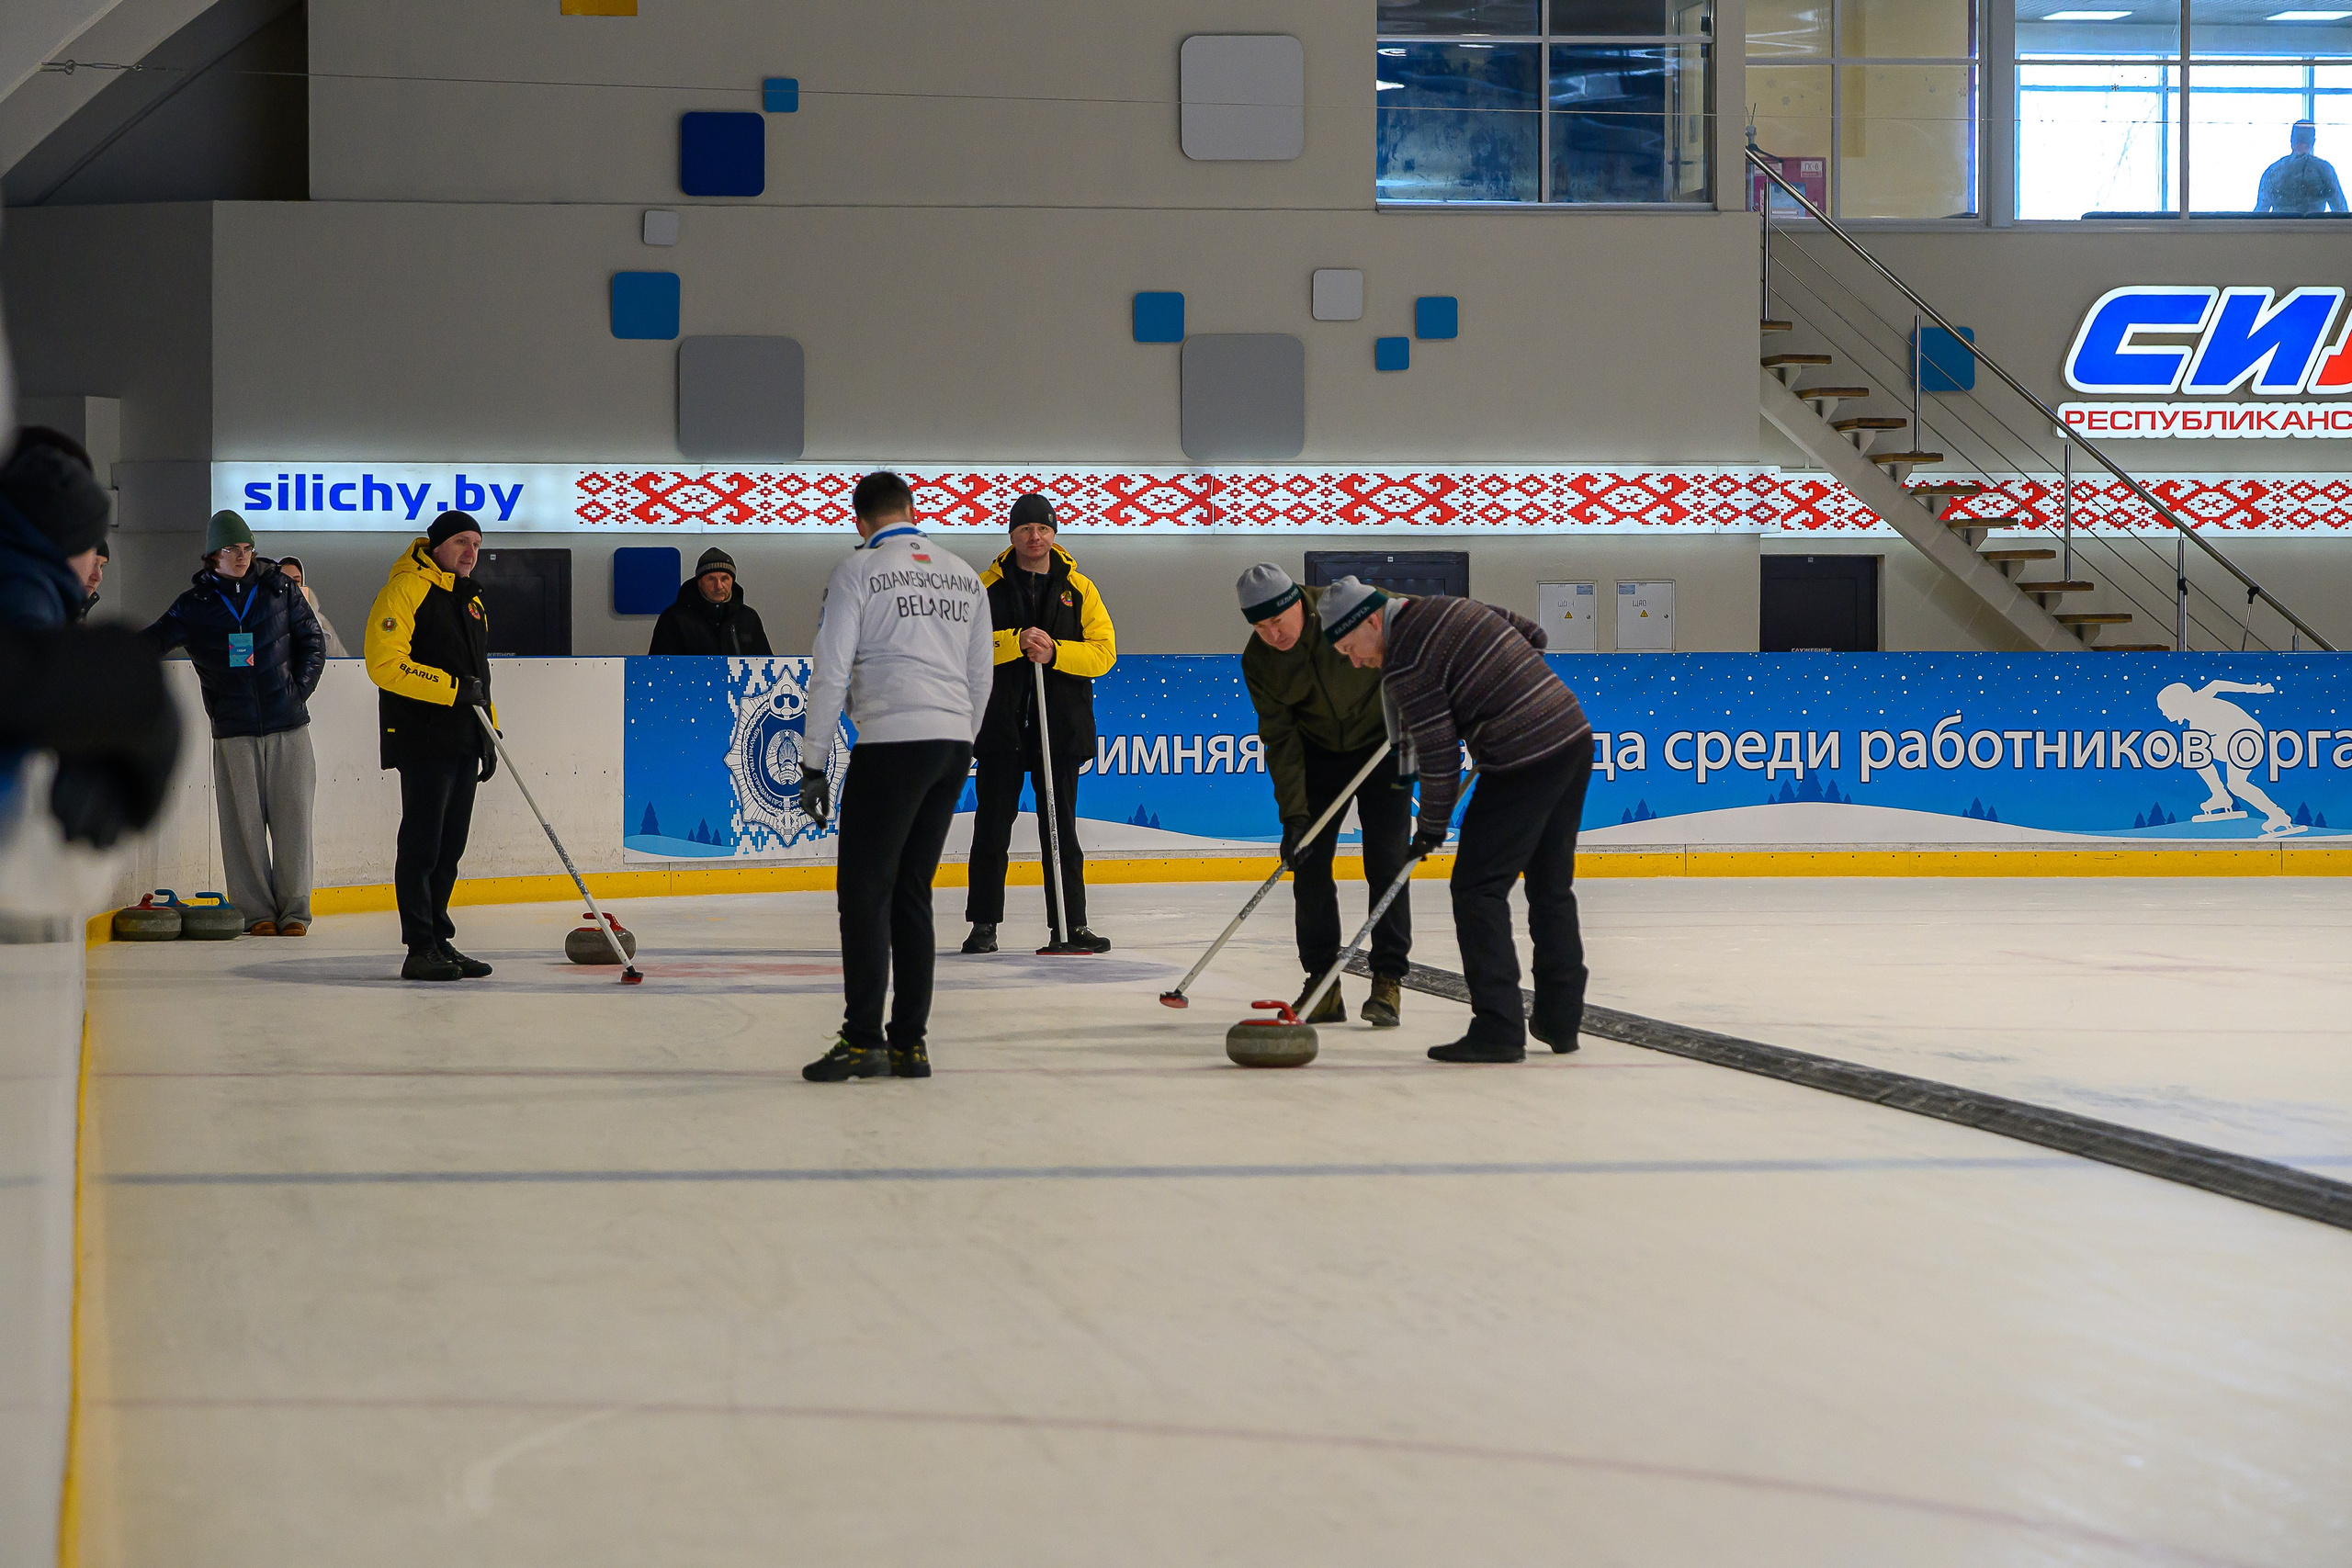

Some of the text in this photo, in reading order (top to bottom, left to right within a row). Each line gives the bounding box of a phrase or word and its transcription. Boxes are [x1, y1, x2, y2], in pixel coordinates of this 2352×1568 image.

[2064, 410, 2352, 431] РЕСПУБЛИКАНС
[243, 473, 525, 522] silichy.by
[1080, 735, 1266, 774] имняя
[1664, 730, 1839, 784] среди
[1860, 714, 2213, 784] работников
[2227, 729, 2352, 783] орга
